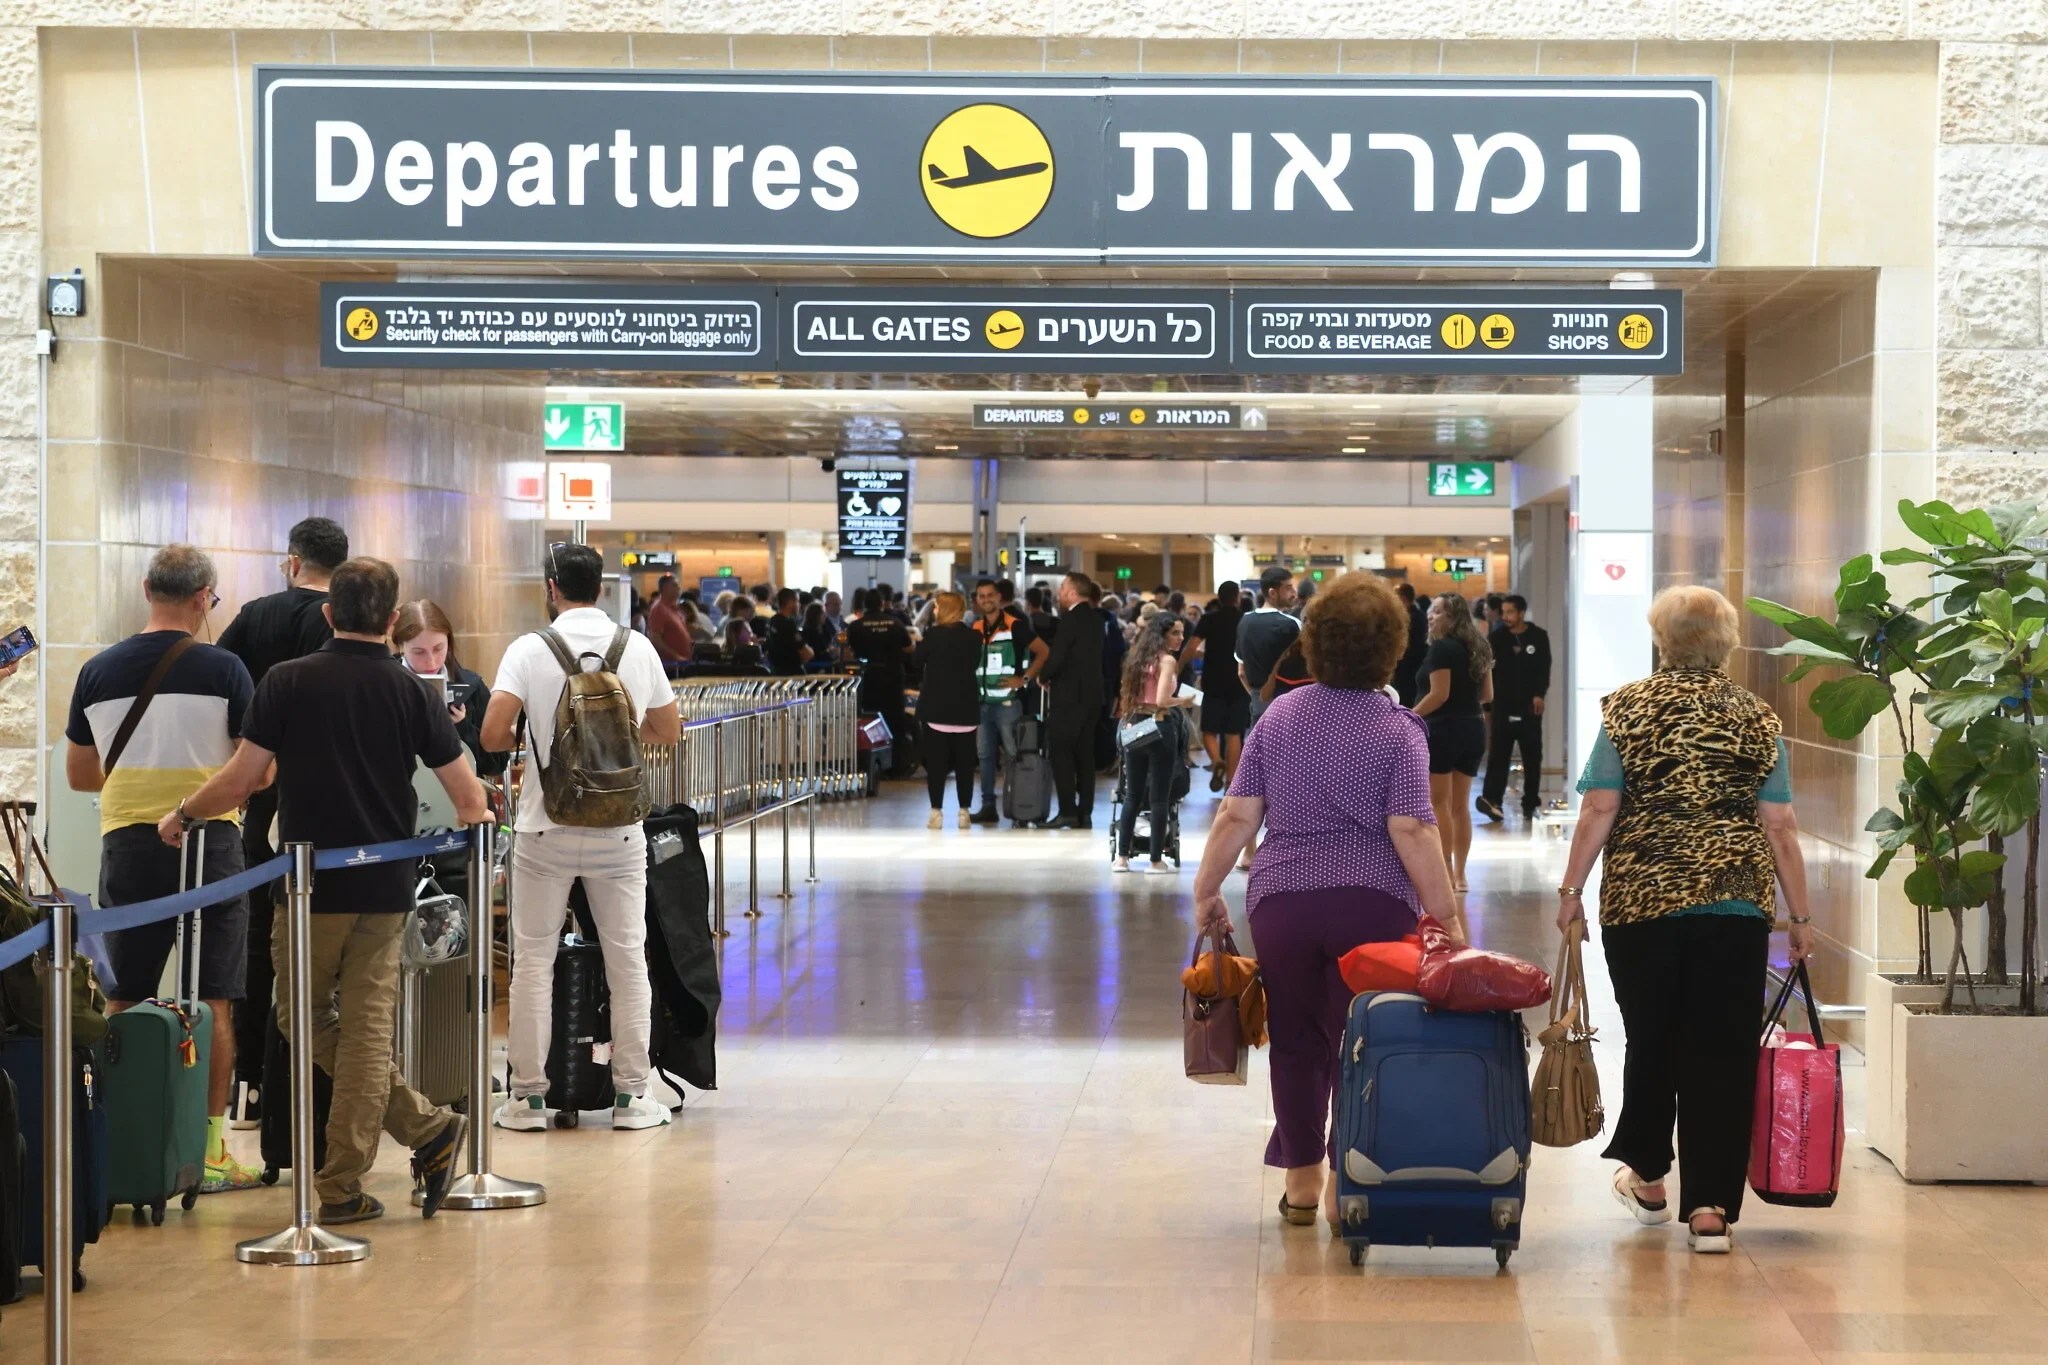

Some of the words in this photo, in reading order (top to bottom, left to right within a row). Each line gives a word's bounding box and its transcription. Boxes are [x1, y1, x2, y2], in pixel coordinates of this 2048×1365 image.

[315, 120, 859, 227] Departures
[1117, 131, 1641, 215] המראות
[385, 306, 431, 324] בלבד
[436, 310, 454, 325] יד
[460, 310, 515, 325] כבודת
[521, 311, 548, 328] עם
[554, 309, 627, 328] לנוסעים
[632, 312, 698, 328] ביטחוני
[705, 313, 752, 330] בידוק
[1261, 313, 1304, 331] קפה
[1309, 313, 1349, 328] ובתי
[1354, 312, 1432, 329] מסעדות
[1552, 313, 1609, 328] חנויות
[807, 316, 865, 341] ALL
[872, 316, 971, 342] GATES
[1038, 318, 1157, 346] השערים
[1166, 313, 1202, 343] כל
[386, 326, 439, 344] Security
[442, 327, 480, 342] check
[483, 328, 502, 342] for
[504, 329, 578, 345] passengers
[581, 328, 608, 343] with
[611, 328, 667, 347] Carry-on
[669, 328, 721, 347] baggage
[723, 330, 752, 348] only
[1264, 334, 1315, 350] FOOD
[1318, 334, 1332, 350] &
[1336, 334, 1432, 350] BEVERAGE
[1547, 334, 1609, 351] SHOPS
[983, 408, 1065, 423] DEPARTURES
[1156, 409, 1231, 424] המראות
